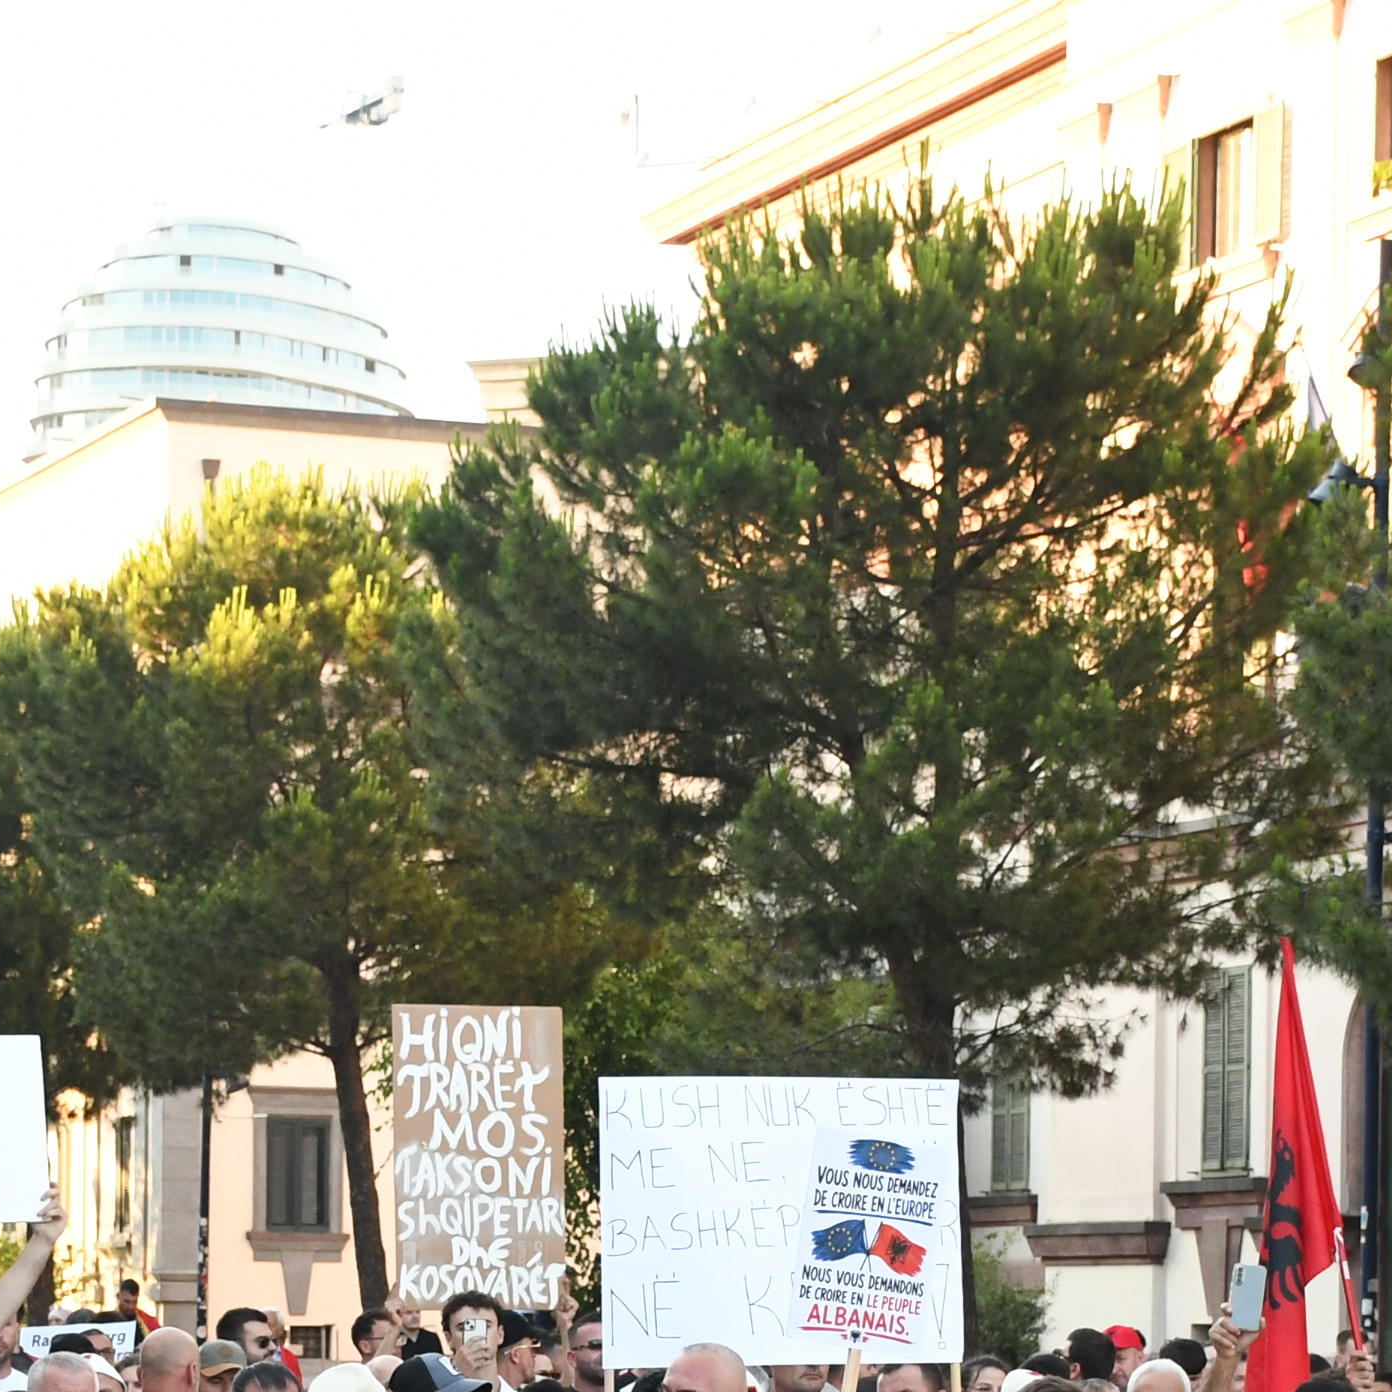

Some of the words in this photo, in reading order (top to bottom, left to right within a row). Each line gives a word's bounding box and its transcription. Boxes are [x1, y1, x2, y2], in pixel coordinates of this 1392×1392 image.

[605, 1083, 723, 1130] KUSH
[744, 1083, 816, 1127] NUK
[836, 1081, 949, 1127] ËSHTË
[428, 1107, 549, 1158] MOS
[611, 1147, 676, 1191] ME
[817, 1165, 849, 1187] VOUS
[853, 1172, 885, 1193] NOUS
[887, 1177, 939, 1198] DEMANDEZ
[813, 1188, 828, 1207] DE
[831, 1191, 868, 1212] CROIRE
[870, 1196, 884, 1213] EN
[887, 1198, 937, 1220] L'EUROPE.
[802, 1264, 833, 1284] NOUS
[836, 1270, 865, 1289] VOUS
[868, 1274, 925, 1298] DEMANDONS
[611, 1272, 681, 1347] NË
[799, 1284, 812, 1299] DE
[814, 1287, 848, 1305] CROIRE
[851, 1292, 864, 1307] EN
[867, 1294, 879, 1309] LE
[882, 1296, 922, 1316] PEUPLE
[807, 1303, 910, 1337] ALBANAIS.
